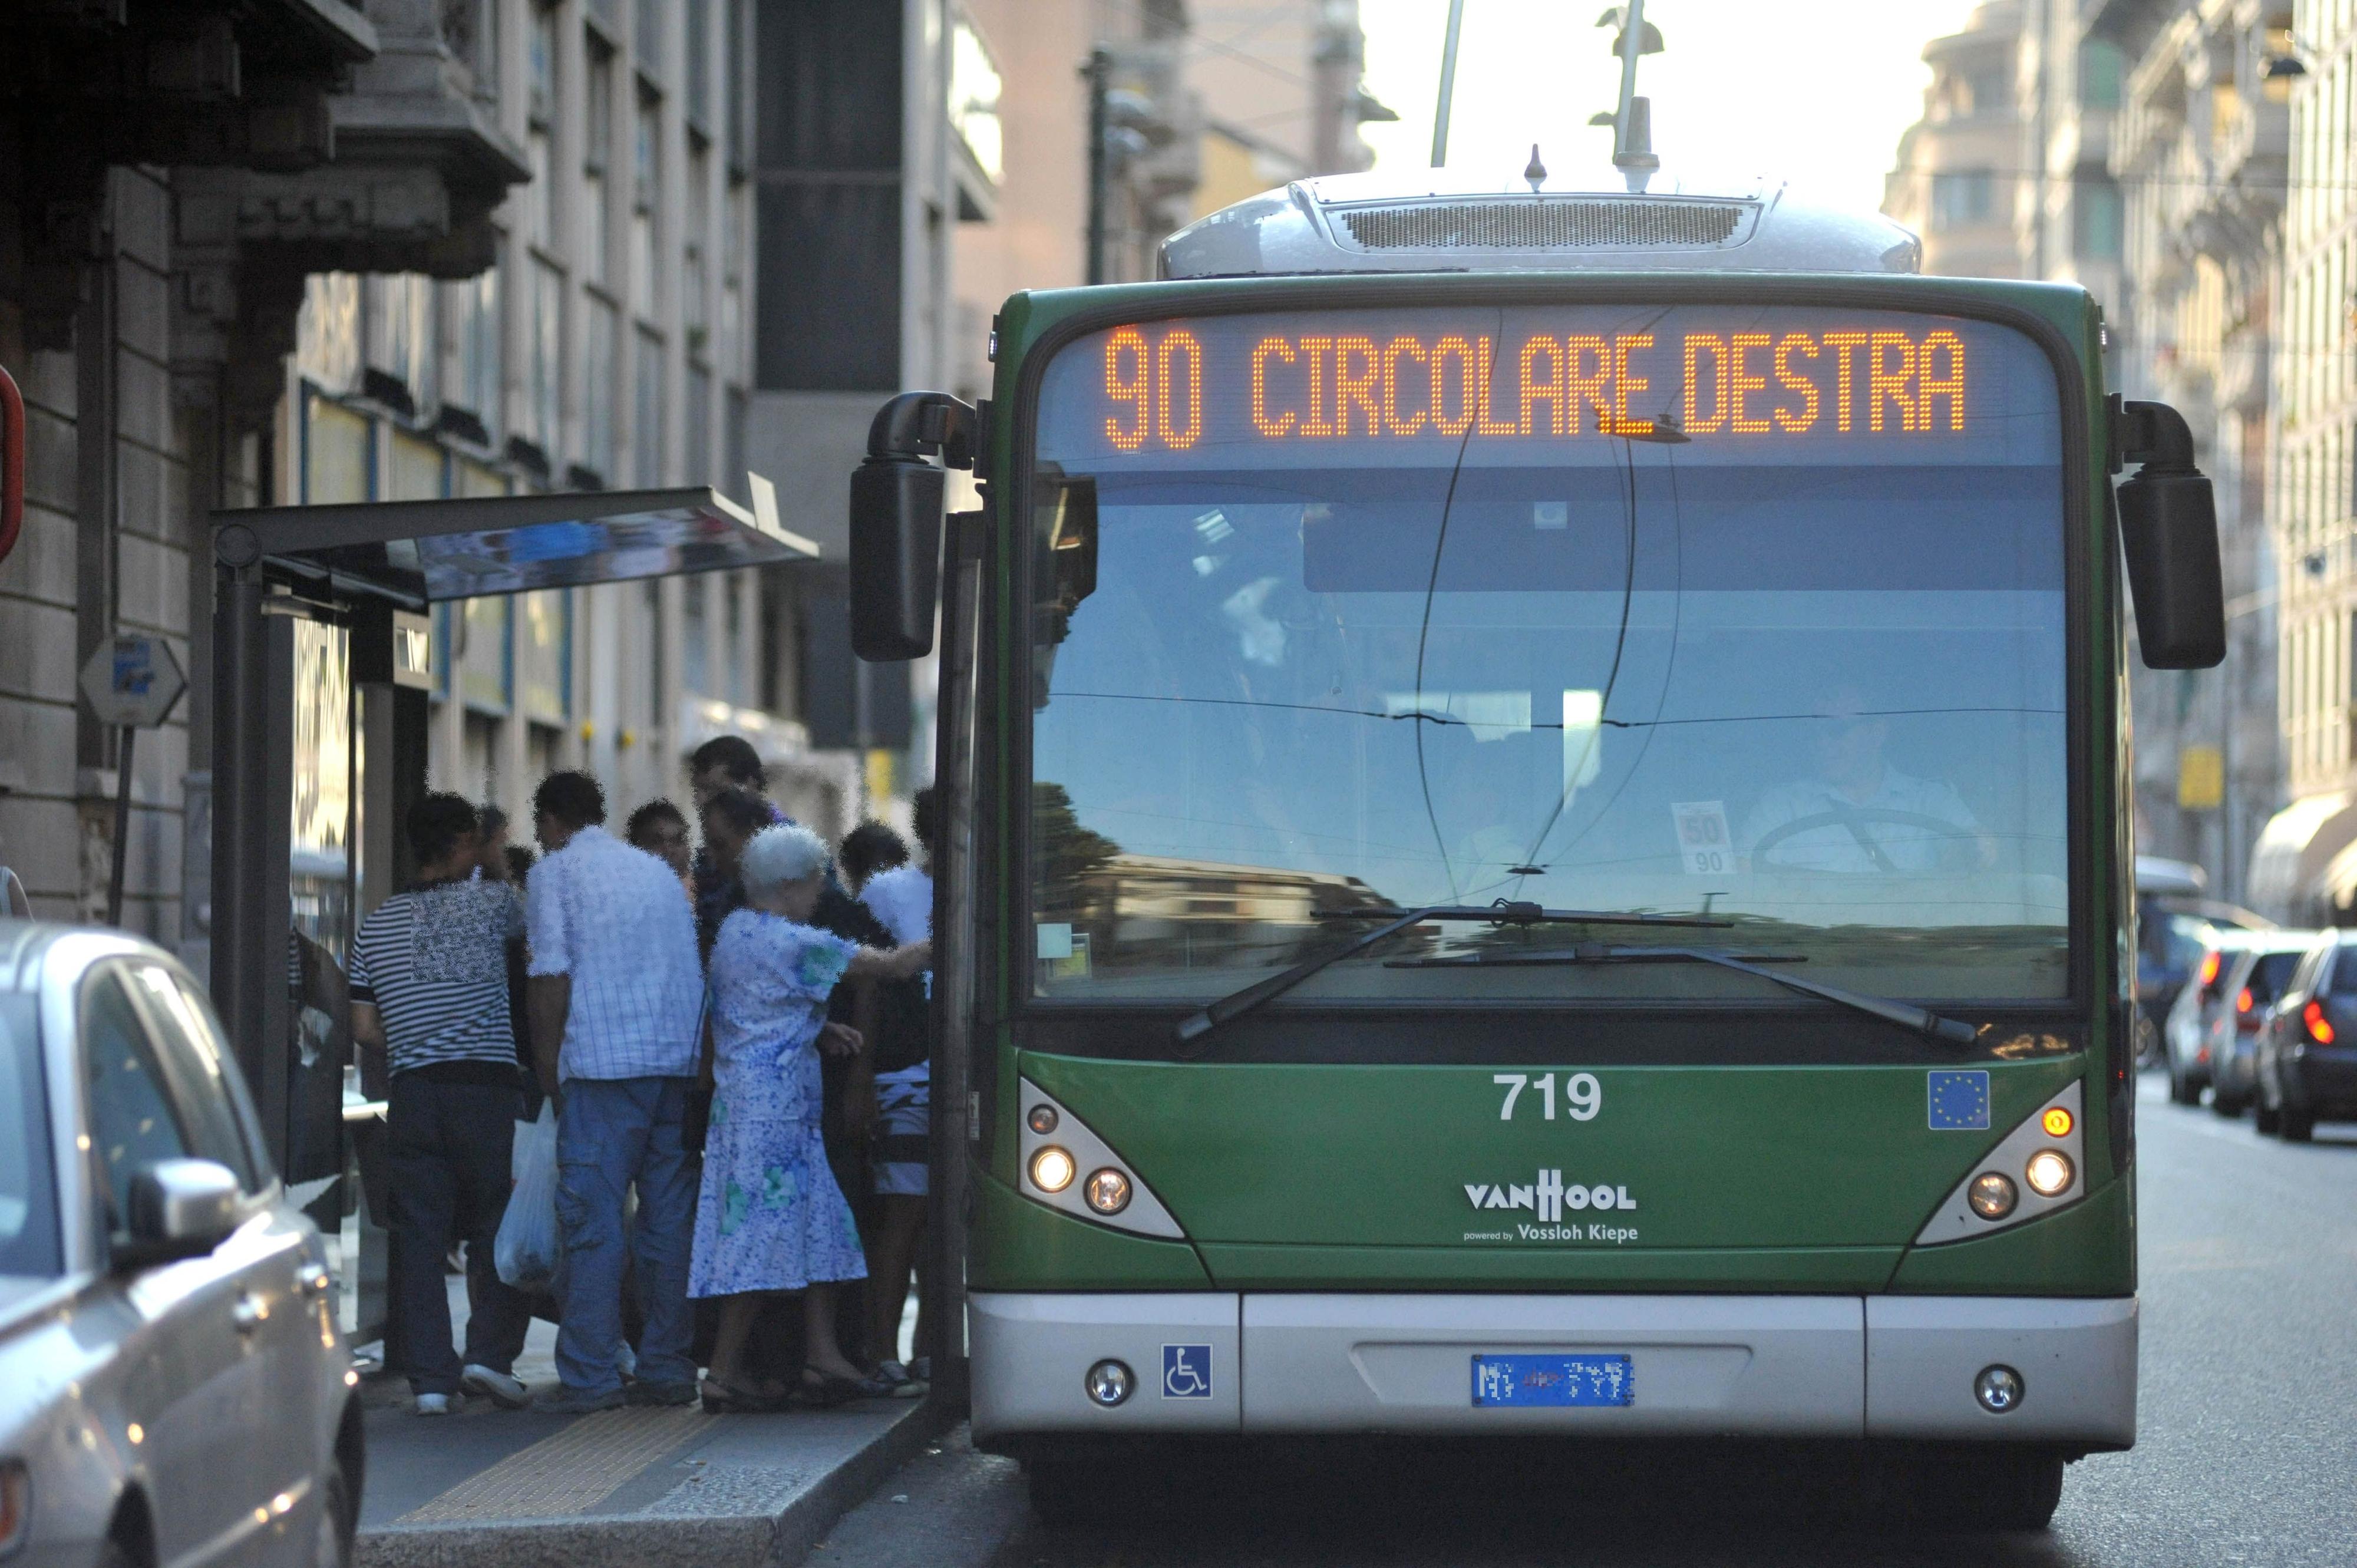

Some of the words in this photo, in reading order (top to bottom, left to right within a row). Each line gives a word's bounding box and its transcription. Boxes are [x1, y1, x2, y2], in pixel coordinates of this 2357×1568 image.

[1105, 331, 1201, 449] 90
[1253, 335, 1653, 437] CIRCOLARE
[1683, 331, 1965, 433] DESTRA
[1695, 852, 1722, 872] 90
[1493, 1073, 1602, 1121] 719
[1464, 1231, 1501, 1241] powered
[1503, 1231, 1514, 1241] by
[1517, 1224, 1582, 1240] Vossloh
[1589, 1224, 1639, 1245] Kiepe
